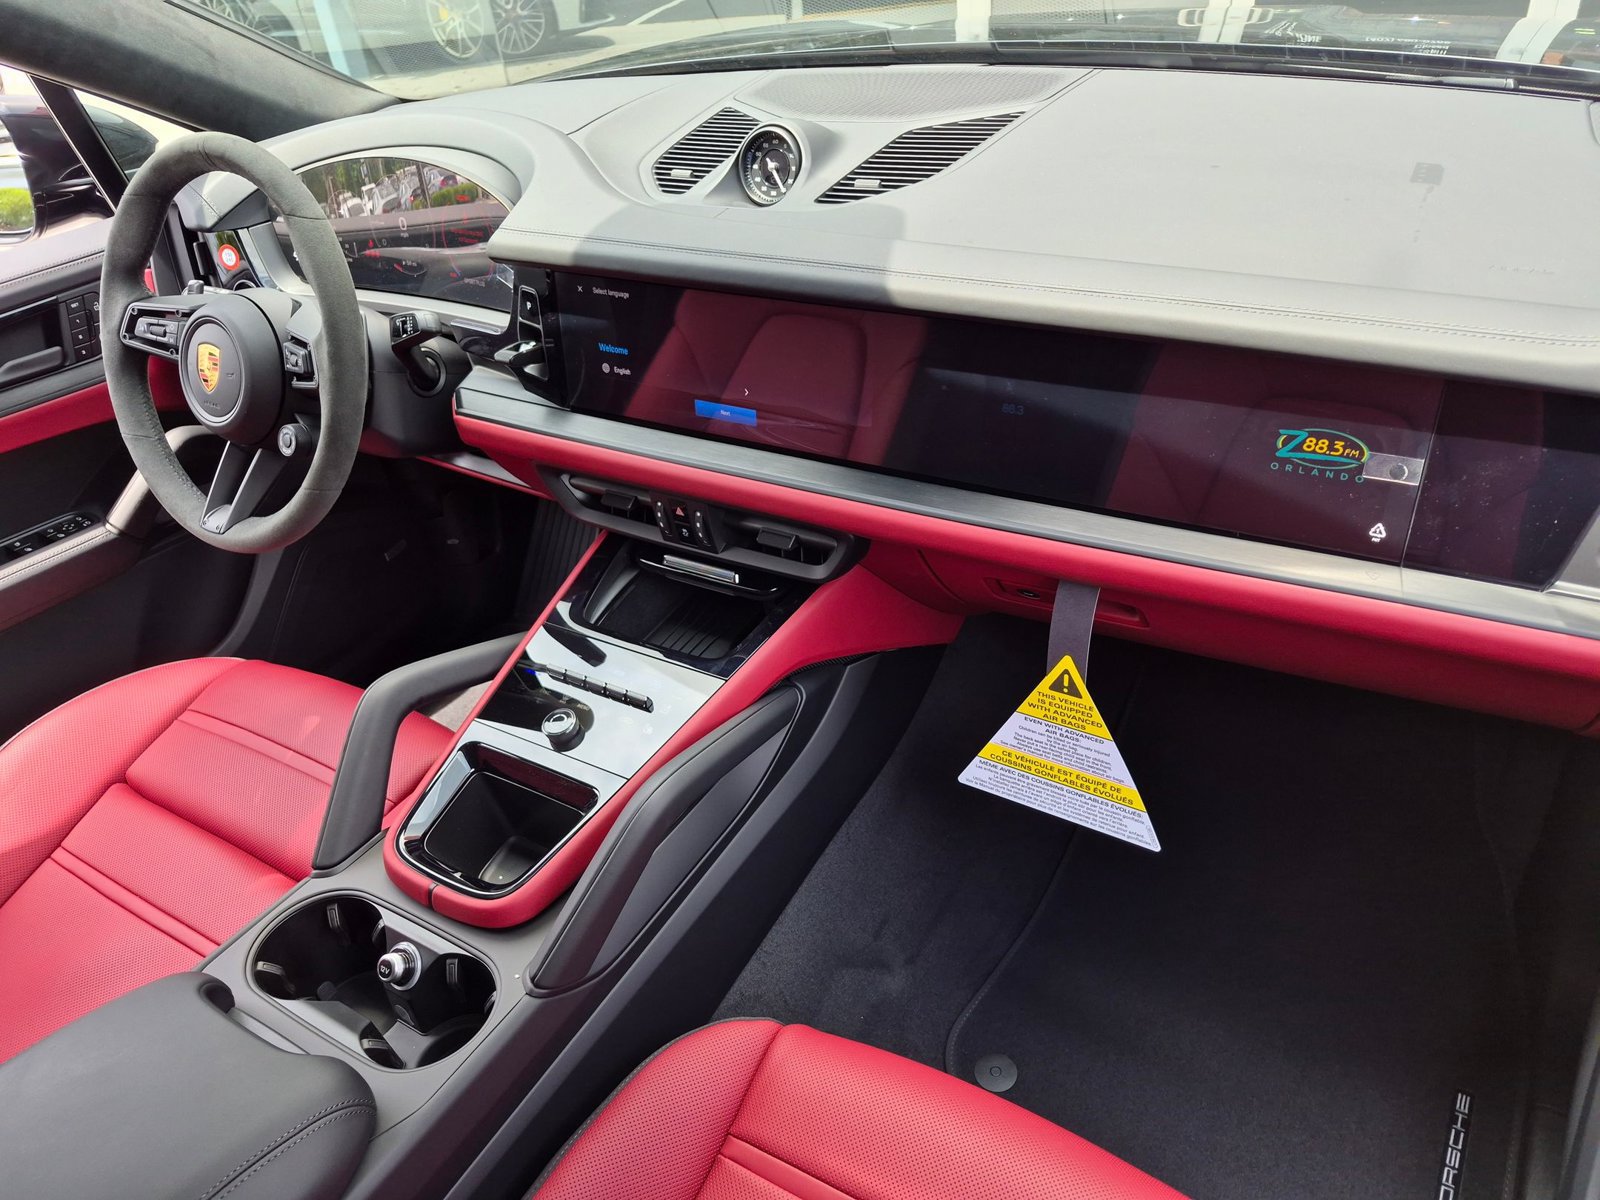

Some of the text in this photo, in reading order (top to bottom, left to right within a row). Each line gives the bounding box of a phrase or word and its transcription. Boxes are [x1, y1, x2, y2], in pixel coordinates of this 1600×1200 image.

[592, 286, 630, 299] Select language
[598, 342, 629, 356] Welcome
[613, 366, 632, 377] English
[1270, 462, 1365, 484] ORLANDO
[1037, 691, 1093, 712] THIS VEHICLE
[1049, 701, 1092, 718] EQUIPPED
[1028, 701, 1102, 728] WITH ADVANCED
[1042, 713, 1085, 730] AIR BAGS
[1024, 716, 1104, 744] EVEN WITH ADVANCED
[990, 753, 1133, 805] COUSSINS GONFLABLES ÉVOLUÉS
[1002, 749, 1121, 793] CE VÉHICULE EST ÉQUIPÉ DE
[999, 766, 1016, 775] AVEC
[1017, 771, 1029, 780] DES
[1031, 776, 1064, 791] COUSSINS
[1065, 788, 1108, 807] GONFLABLES
[1439, 1092, 1471, 1200] ORSCHE
